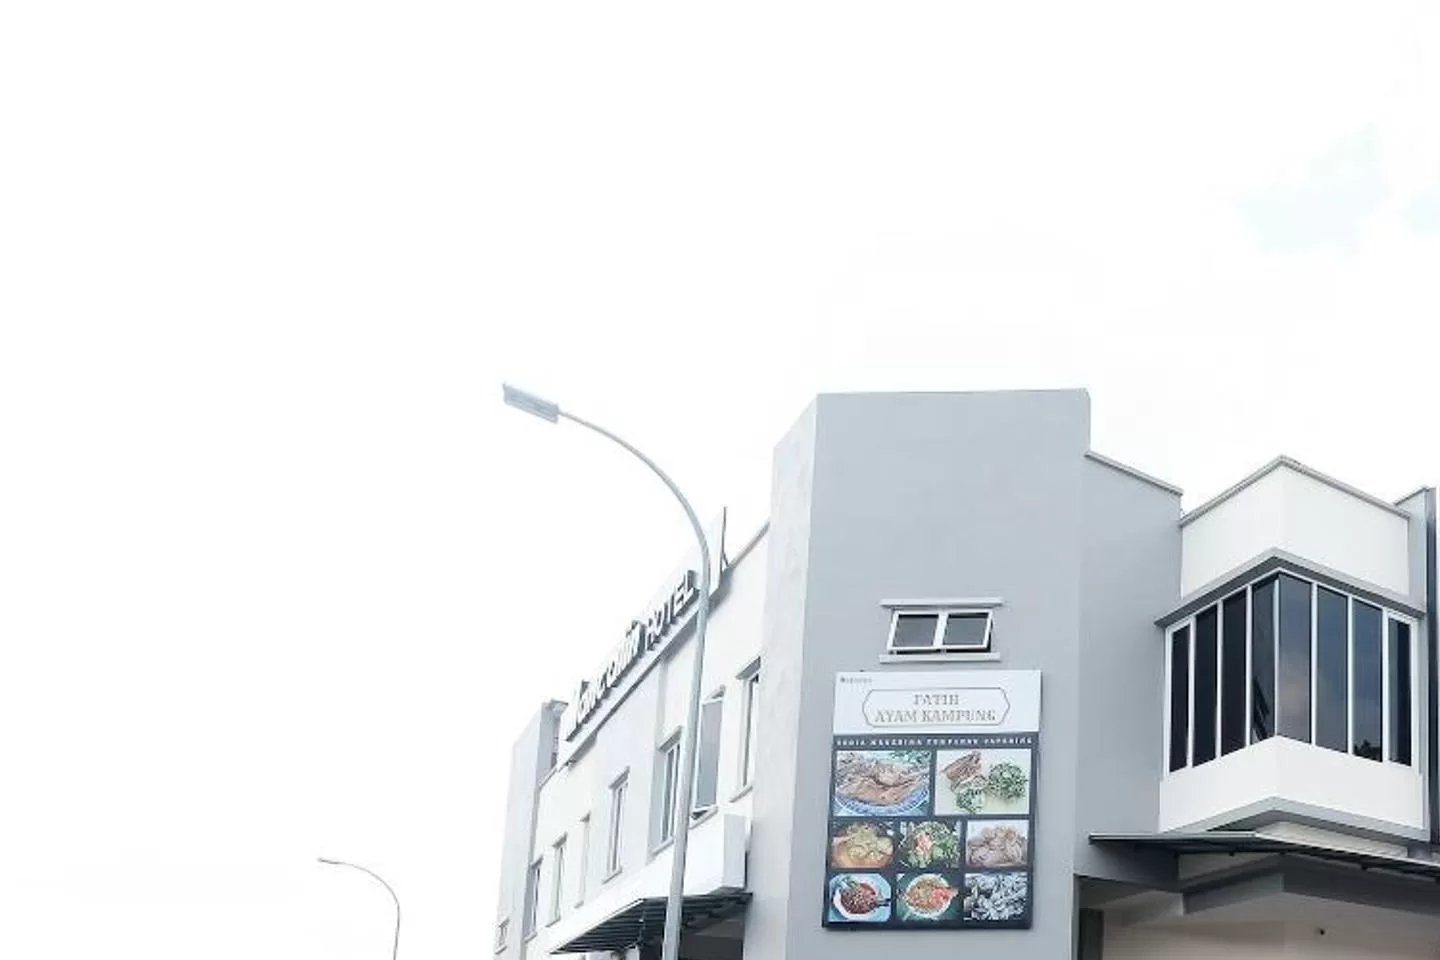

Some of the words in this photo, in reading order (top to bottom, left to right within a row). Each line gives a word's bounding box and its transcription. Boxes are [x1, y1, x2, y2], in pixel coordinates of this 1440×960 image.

[913, 693, 960, 706] FATIH
[874, 709, 918, 723] AYAM
[921, 709, 996, 722] KAMPUNG
